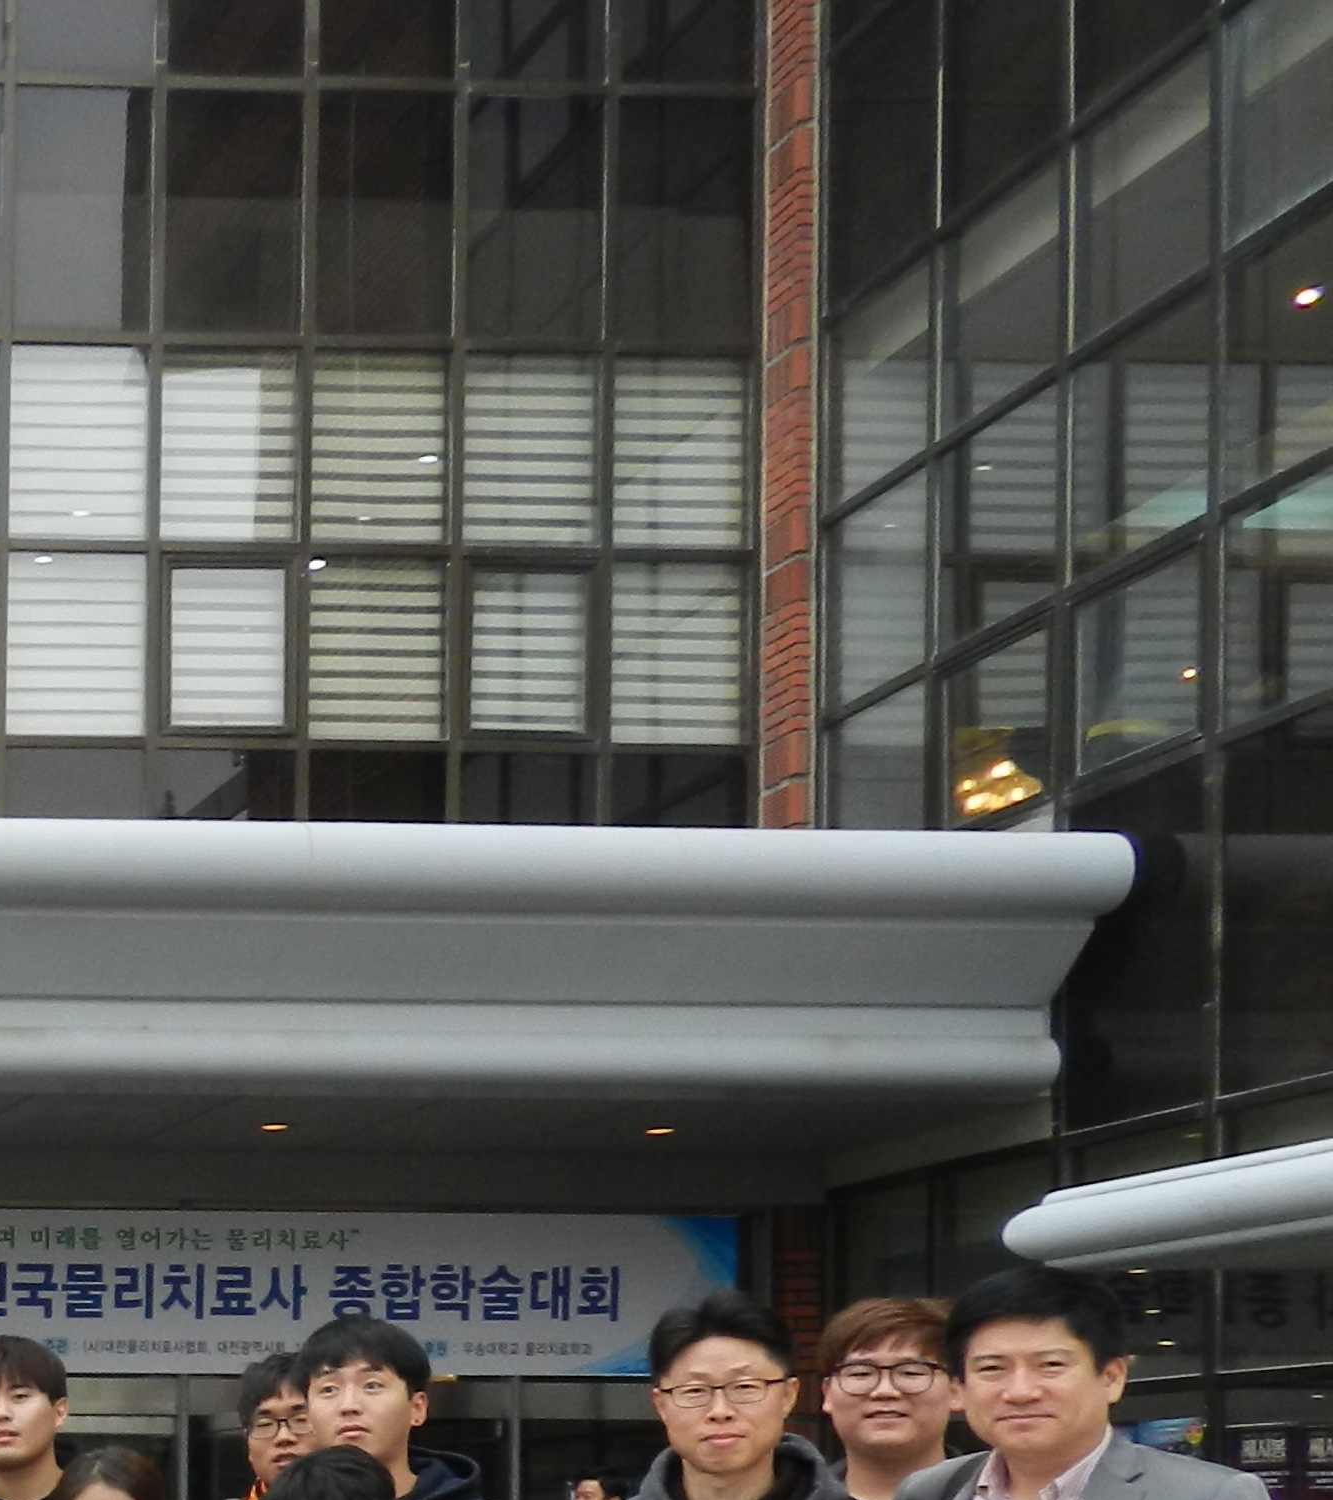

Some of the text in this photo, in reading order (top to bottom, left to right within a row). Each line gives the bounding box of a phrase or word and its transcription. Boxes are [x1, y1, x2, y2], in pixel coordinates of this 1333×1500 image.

[30, 1225, 103, 1251] 미래를
[116, 1227, 213, 1251] 열어가는
[328, 1263, 620, 1323] 종합학술대회
